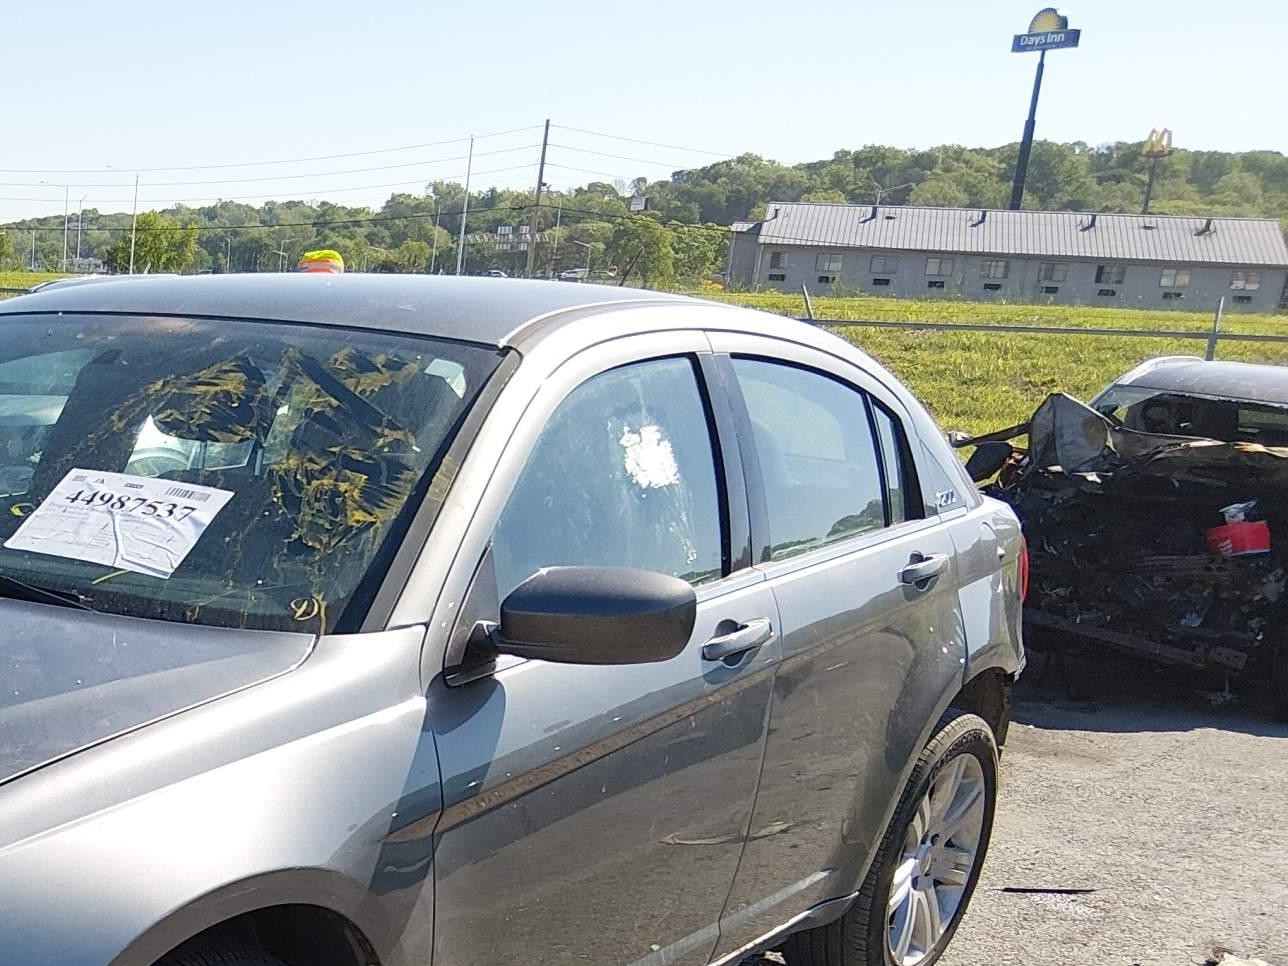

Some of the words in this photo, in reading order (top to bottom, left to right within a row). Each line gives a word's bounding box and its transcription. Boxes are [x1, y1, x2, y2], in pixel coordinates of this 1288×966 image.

[1020, 35, 1046, 46] Days
[1046, 32, 1065, 43] Inn
[65, 489, 197, 522] 44987537
